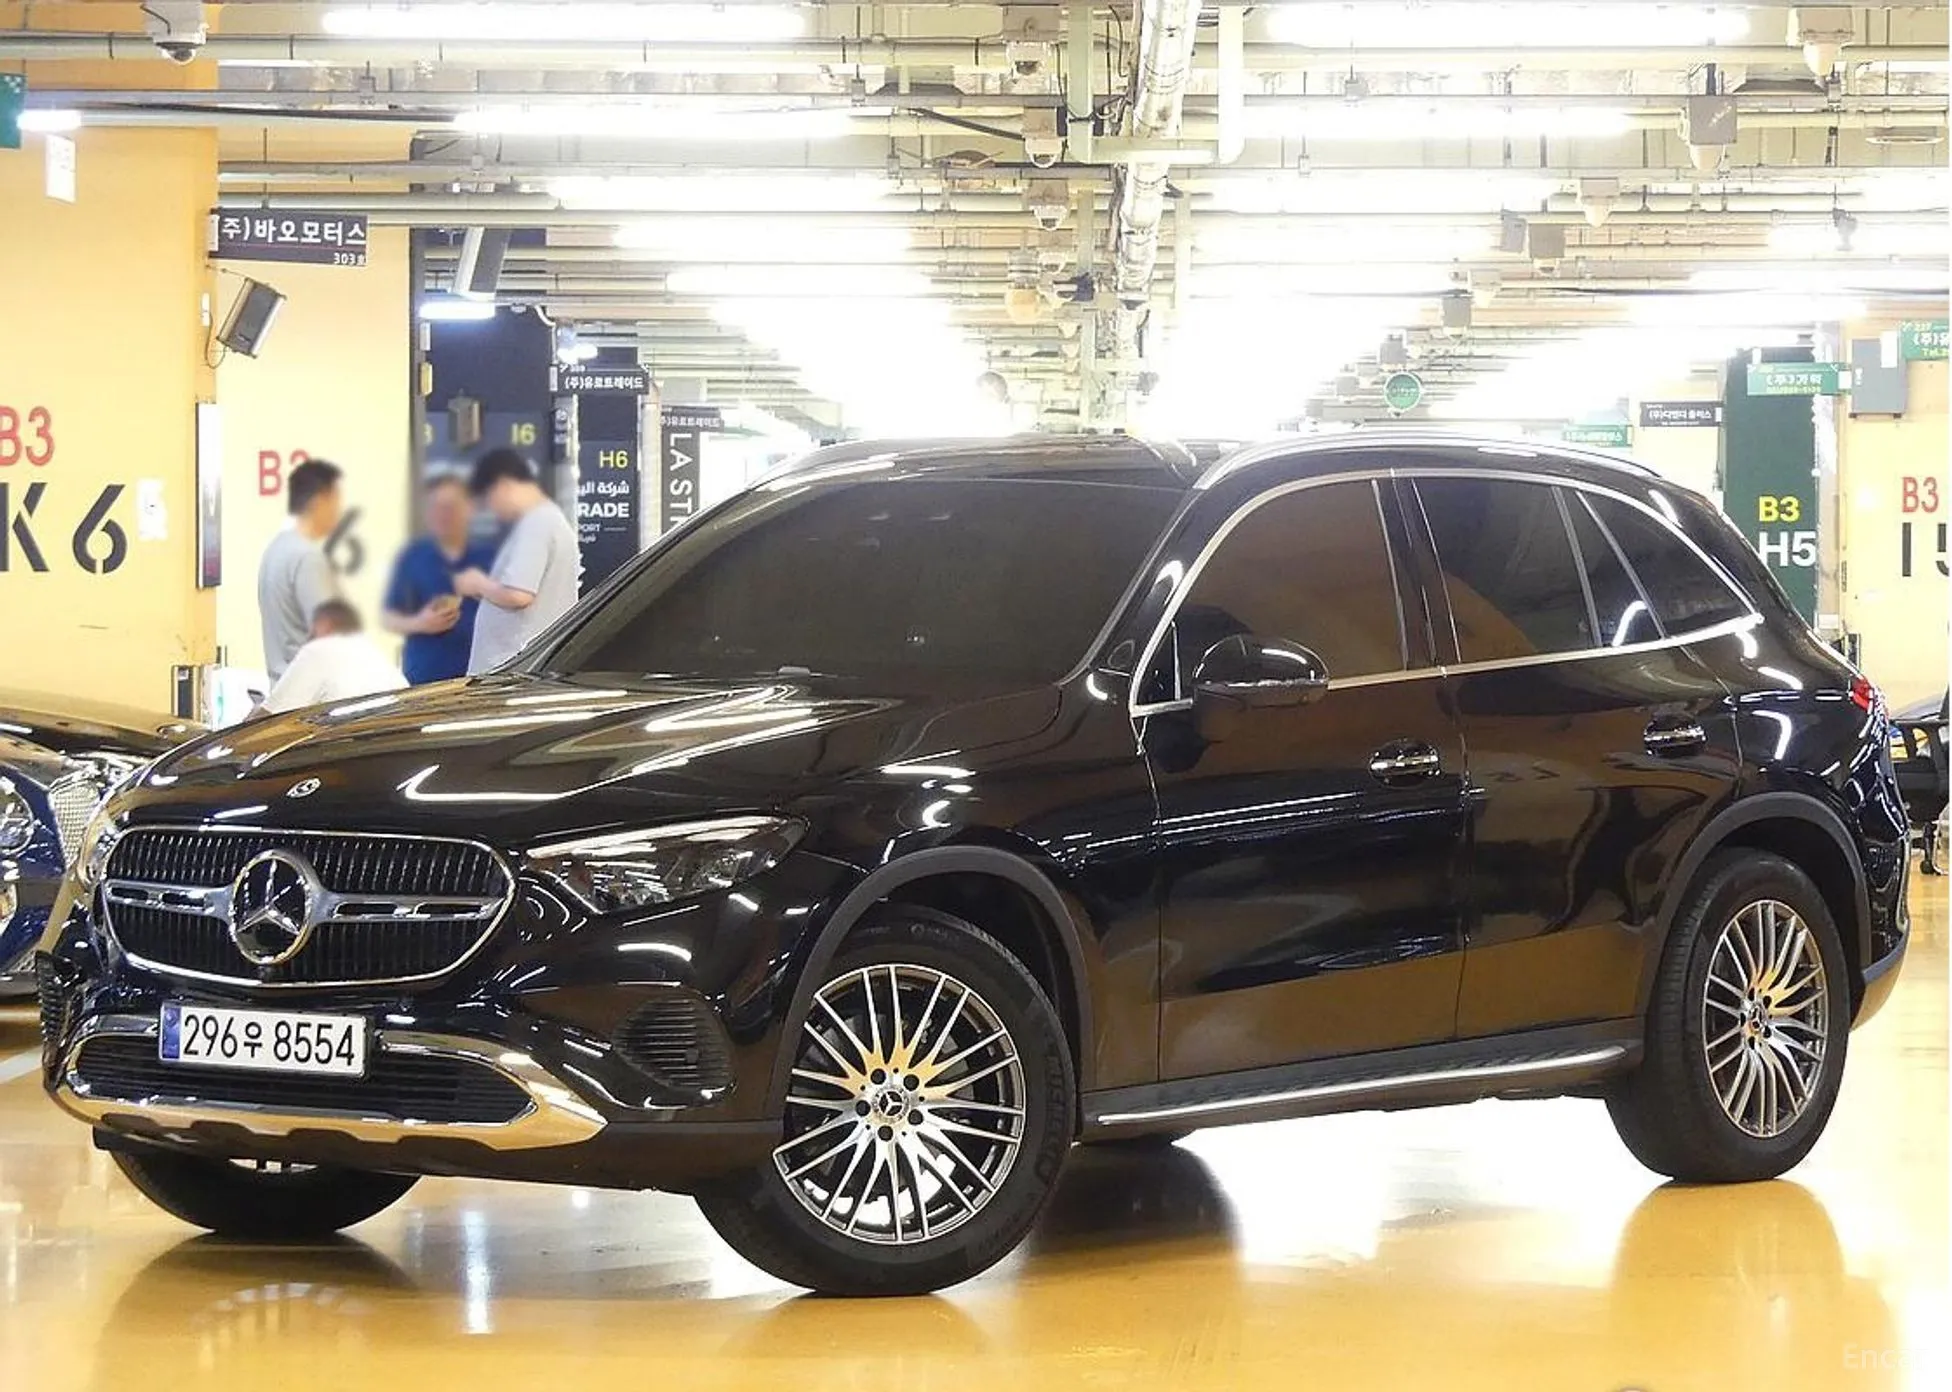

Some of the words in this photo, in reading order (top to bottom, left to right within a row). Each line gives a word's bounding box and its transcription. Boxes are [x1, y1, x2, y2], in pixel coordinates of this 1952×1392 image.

[222, 216, 366, 246] 주)바오모터스
[564, 376, 644, 389] (주)유로트레이드
[0, 406, 55, 466] B3
[669, 433, 693, 471] LA
[599, 451, 628, 468] H6
[577, 502, 630, 518] RADE
[1758, 495, 1801, 522] B3
[1901, 476, 1939, 513] B3
[1759, 531, 1817, 567] H5
[183, 1014, 262, 1059] 296우
[273, 1020, 355, 1066] 8554
